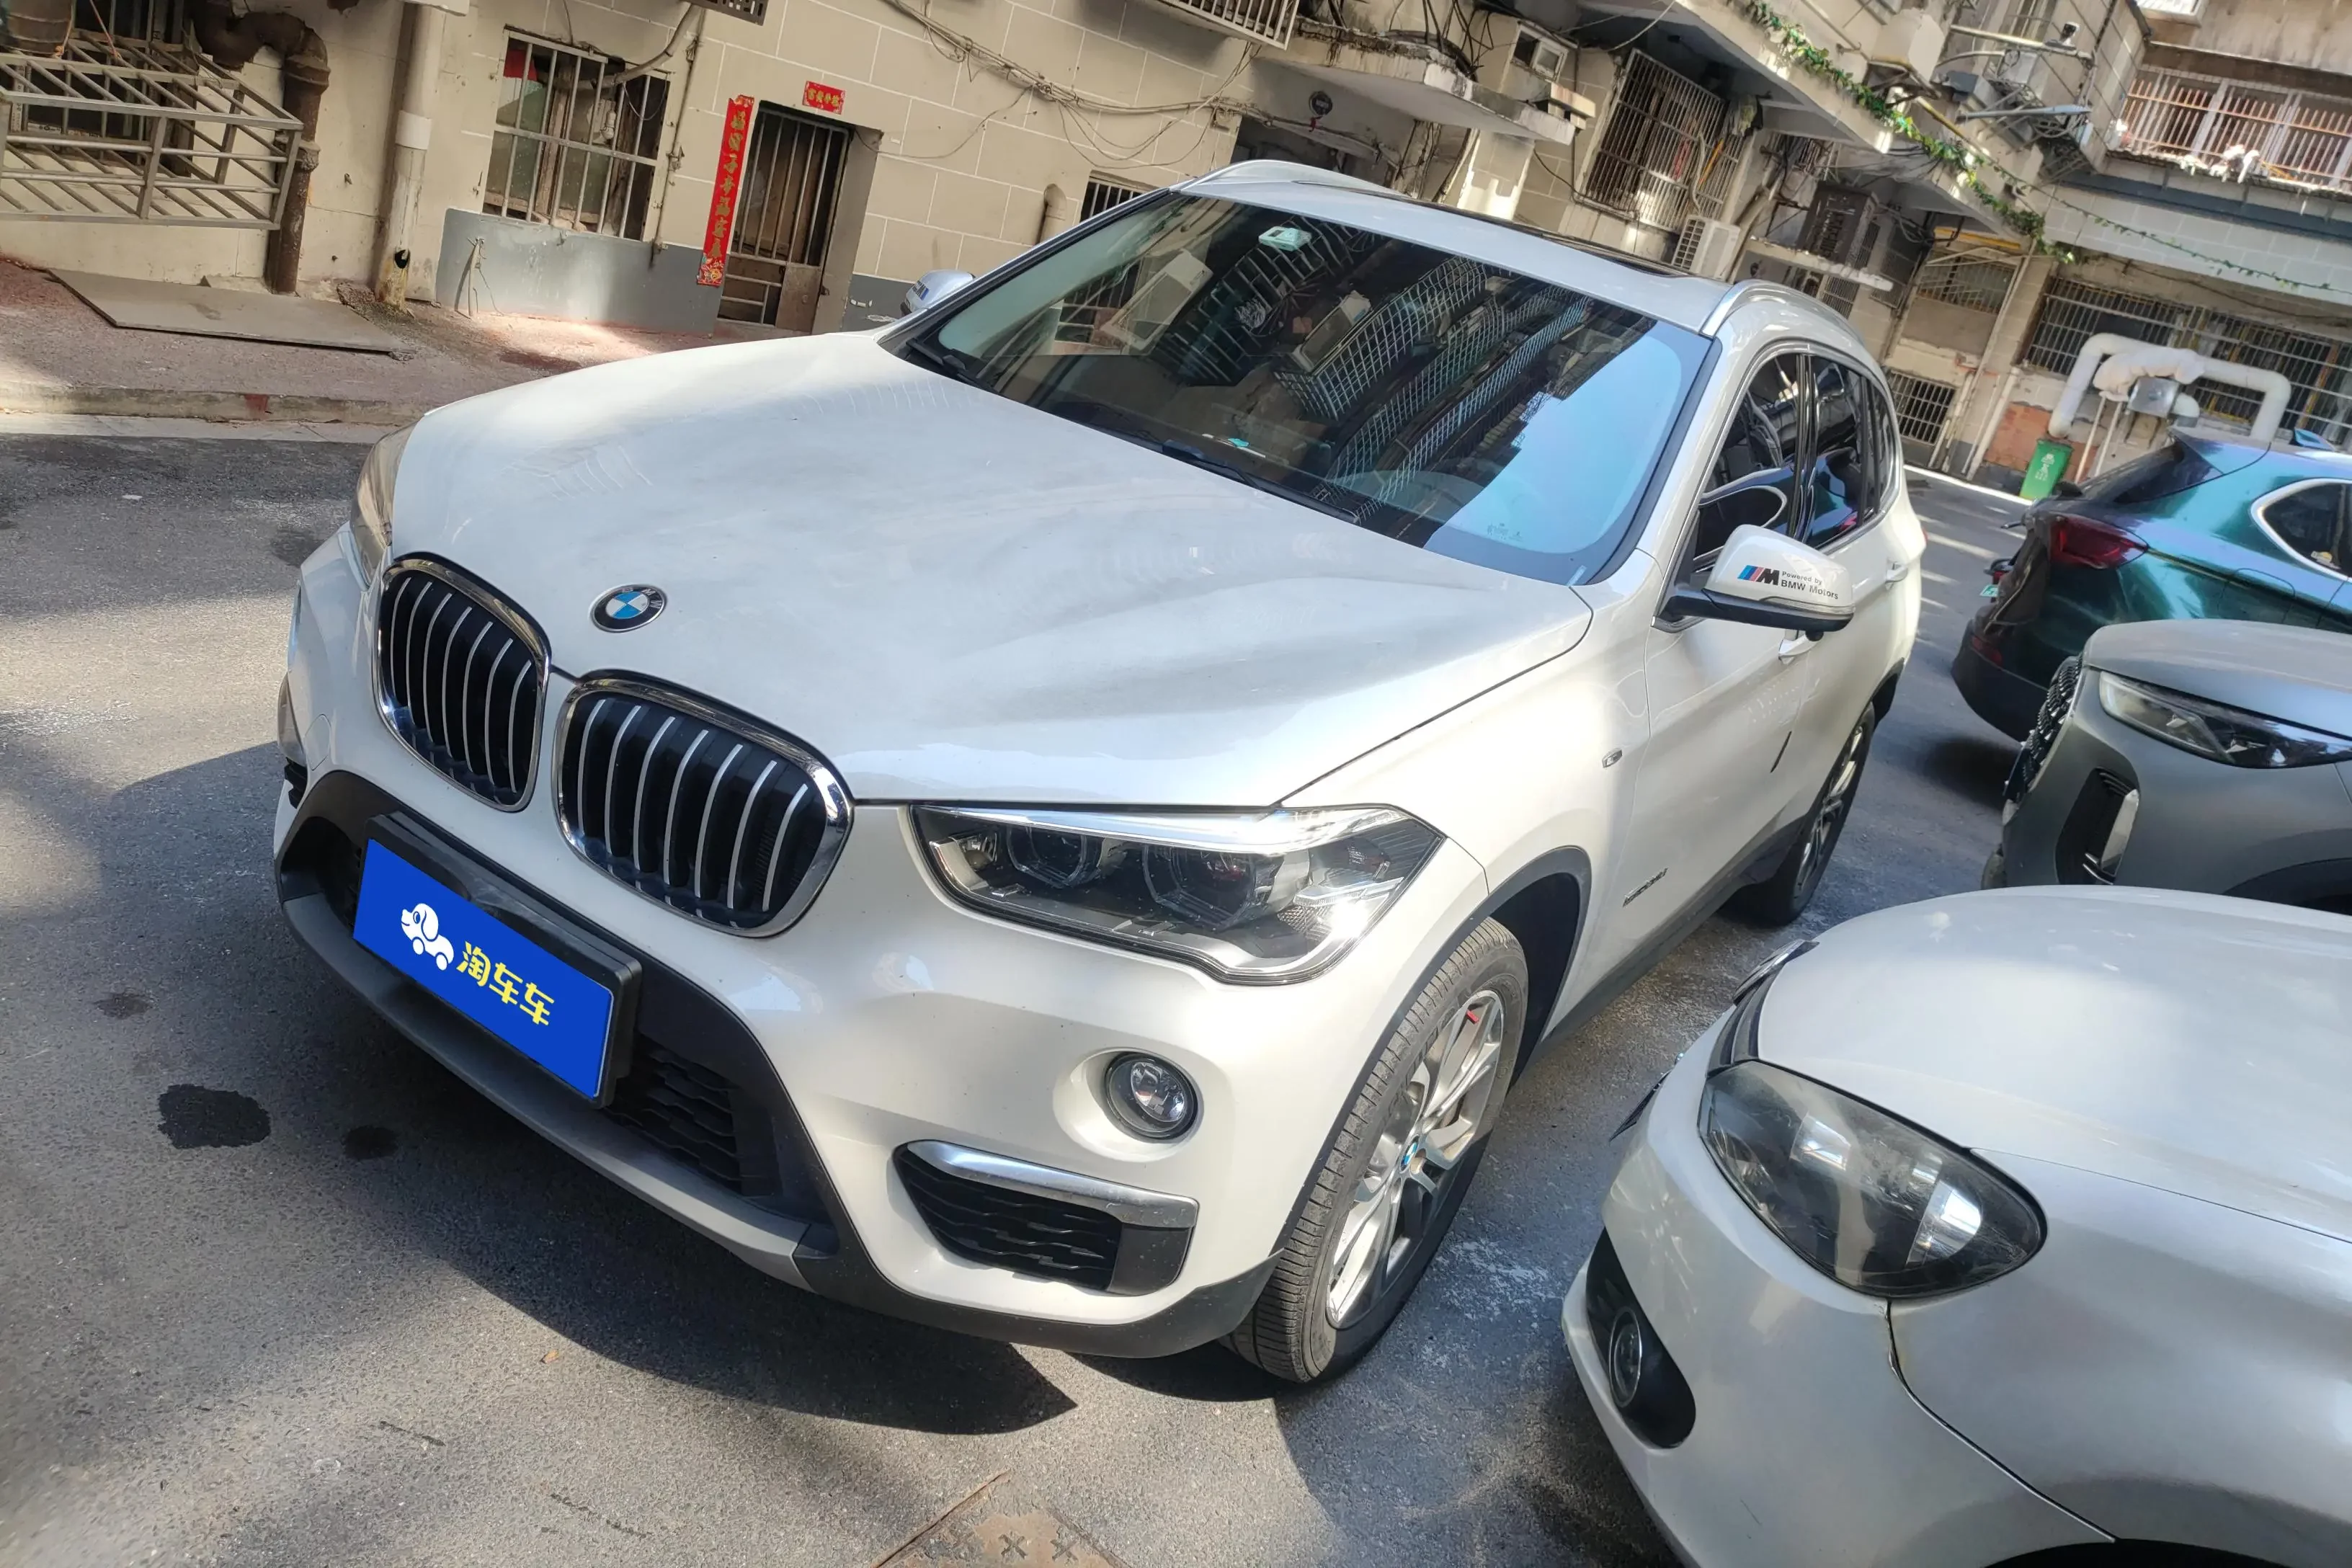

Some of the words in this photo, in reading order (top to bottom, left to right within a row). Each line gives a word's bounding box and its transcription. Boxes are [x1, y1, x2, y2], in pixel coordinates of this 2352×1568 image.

[1781, 571, 1812, 582] Powered
[1814, 577, 1822, 586] by
[621, 587, 662, 610] BMW
[1781, 579, 1806, 592] BMW
[1809, 585, 1839, 600] Motors
